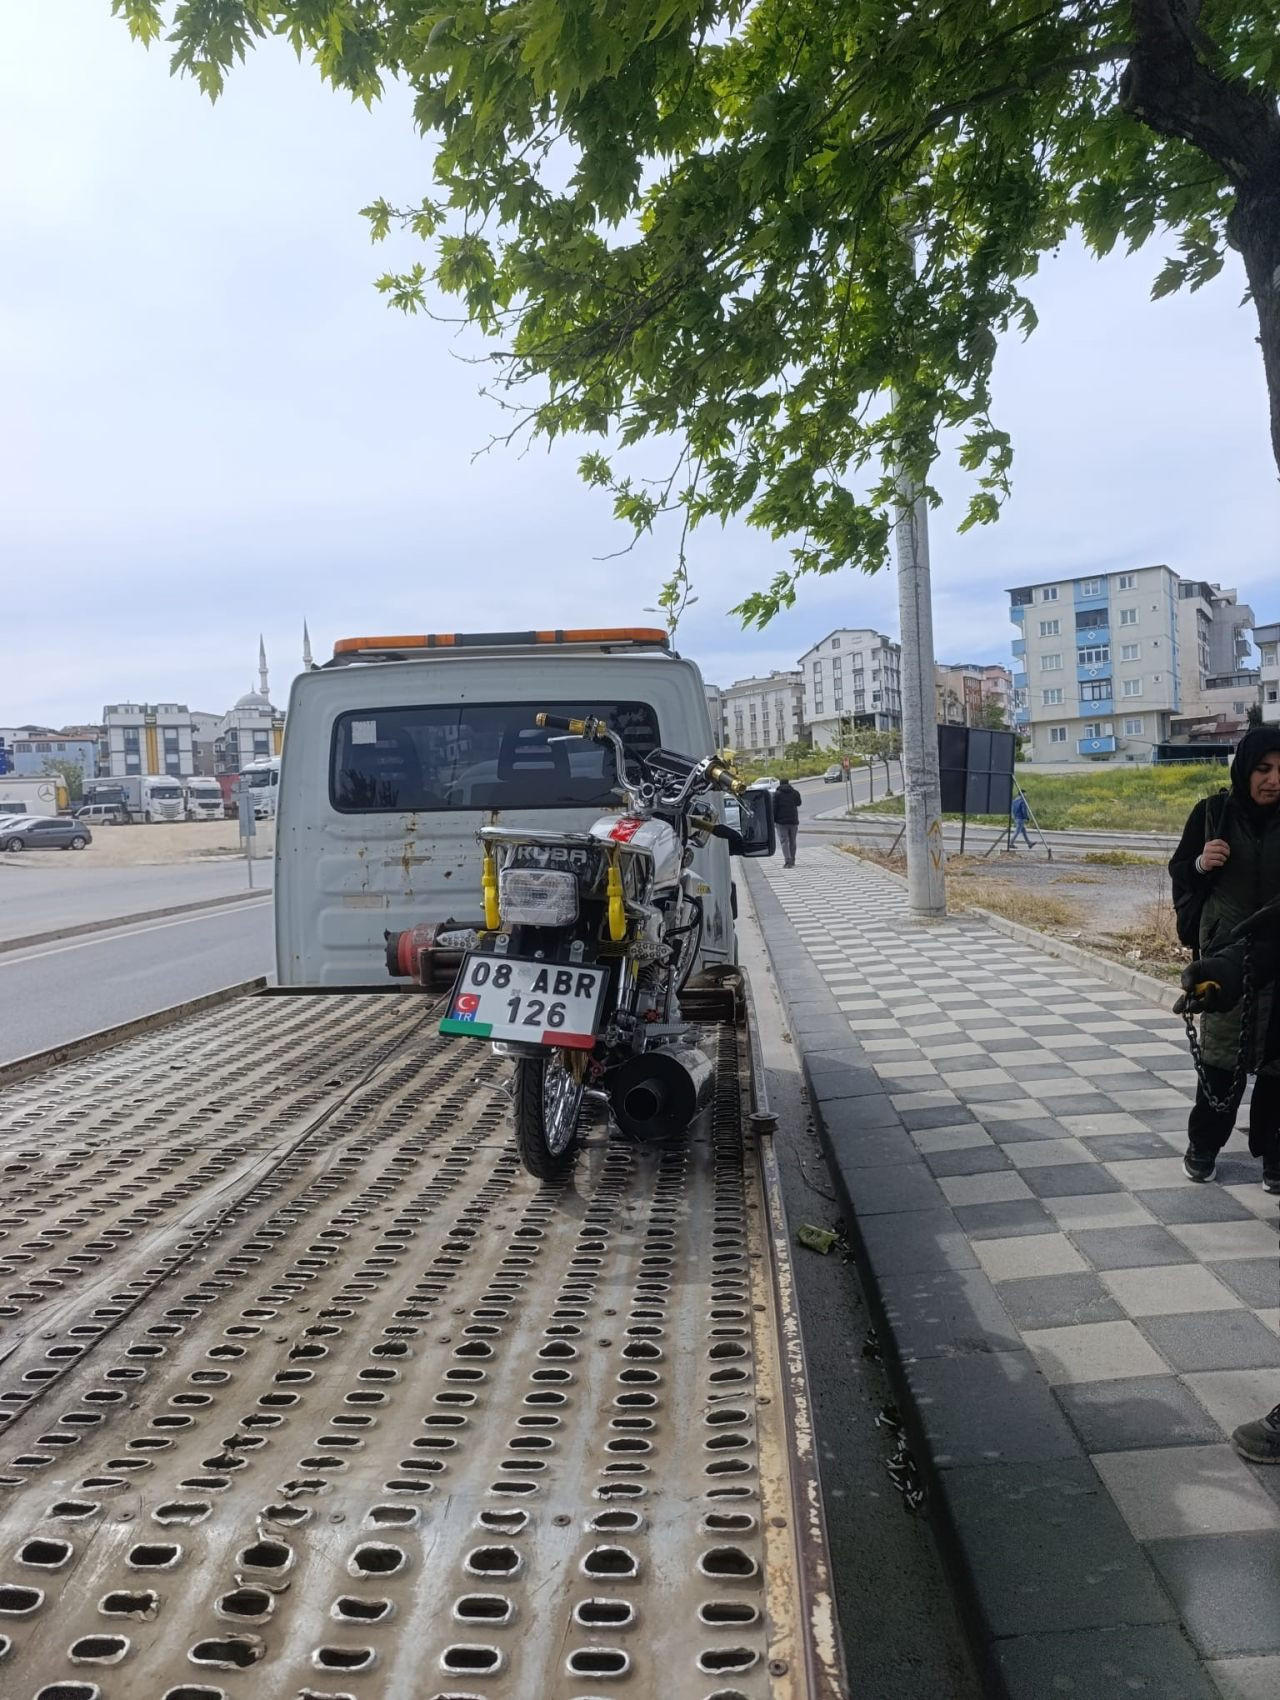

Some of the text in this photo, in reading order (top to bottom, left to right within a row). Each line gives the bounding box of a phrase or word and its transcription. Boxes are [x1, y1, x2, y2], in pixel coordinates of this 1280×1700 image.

[471, 962, 596, 998] 08 ABR
[457, 1011, 472, 1022] TR
[508, 996, 566, 1027] 126
